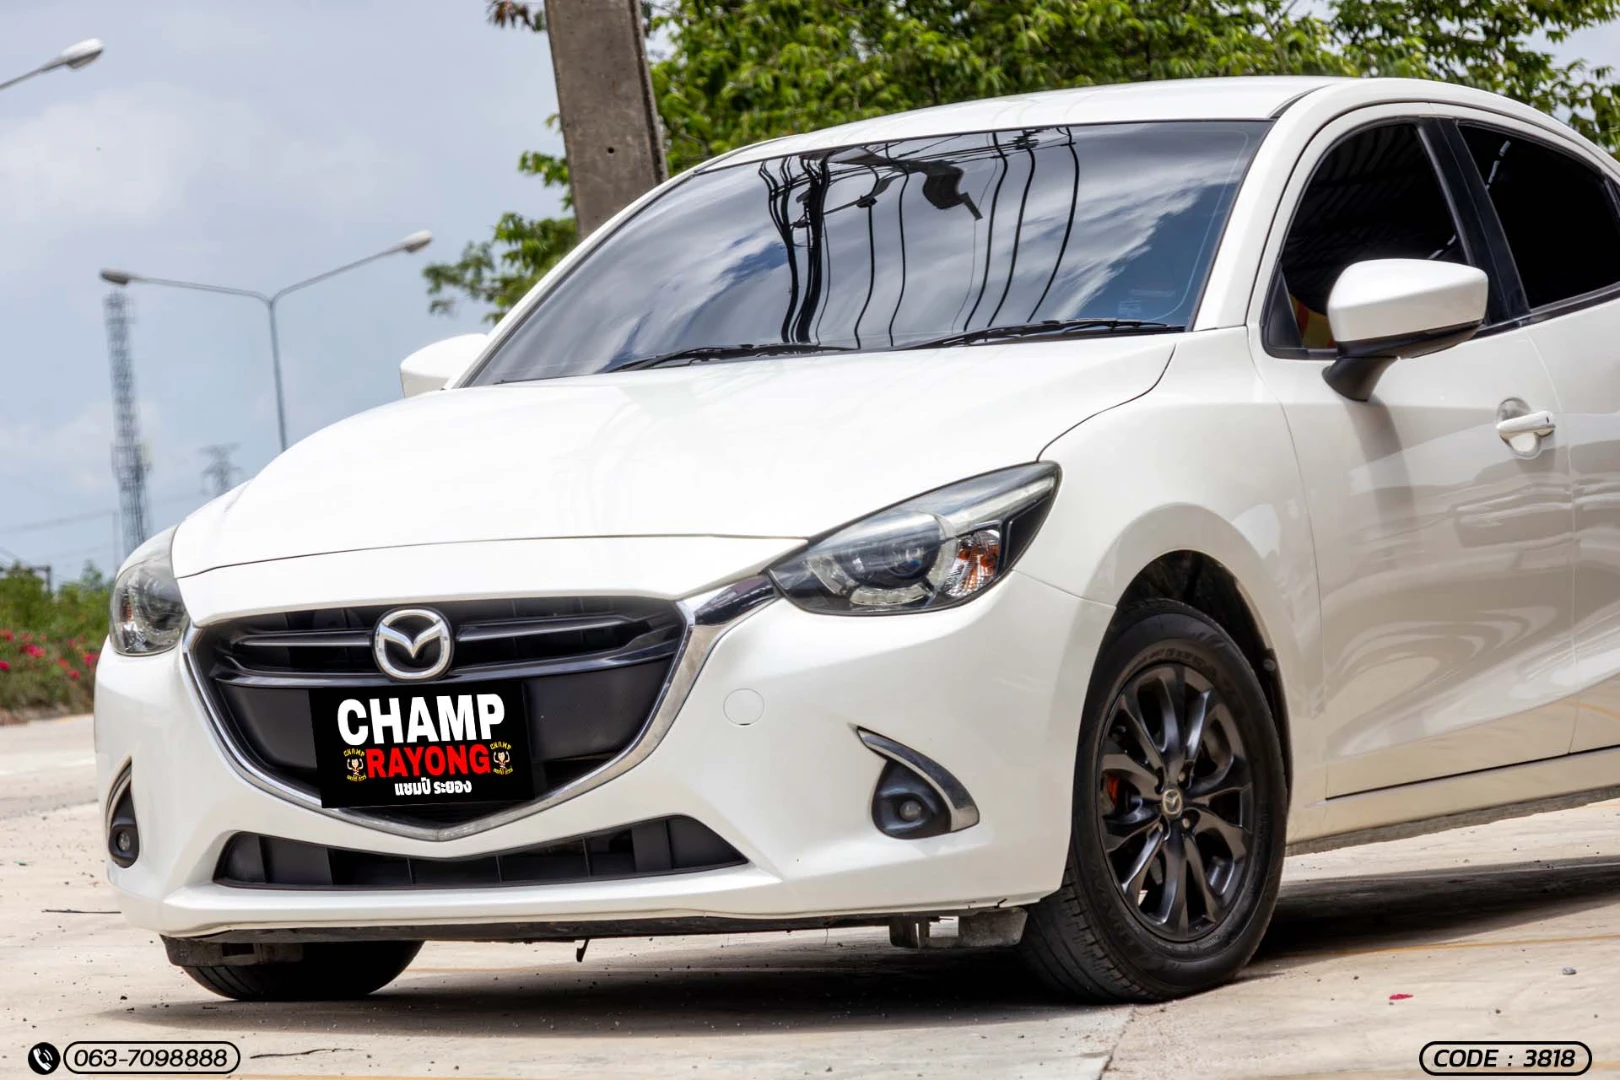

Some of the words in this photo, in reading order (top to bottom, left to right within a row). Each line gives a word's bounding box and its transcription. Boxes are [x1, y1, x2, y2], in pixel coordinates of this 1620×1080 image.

[337, 693, 505, 746] CHAMP
[365, 744, 491, 779] RAYONG
[433, 780, 473, 795] ระยอง
